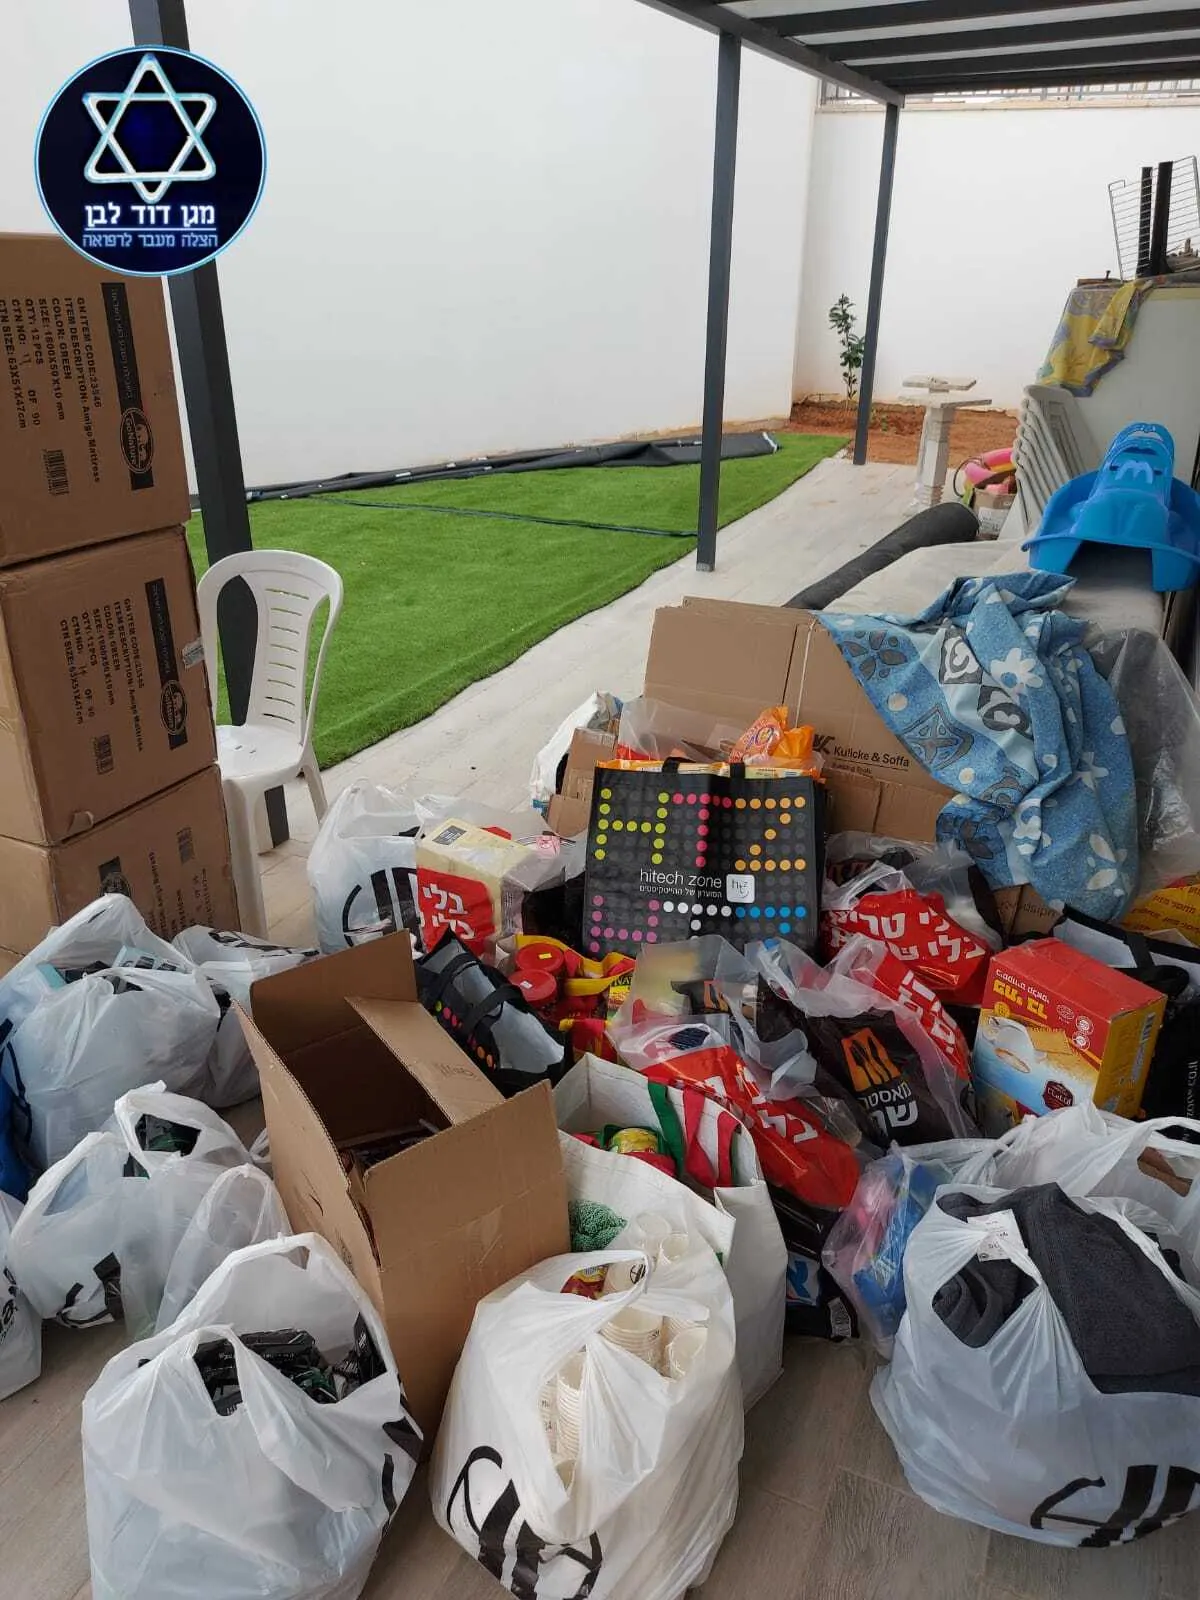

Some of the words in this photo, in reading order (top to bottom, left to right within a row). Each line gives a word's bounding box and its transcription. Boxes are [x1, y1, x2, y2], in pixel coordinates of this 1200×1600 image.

[39, 298, 51, 328] SIZE:
[80, 315, 92, 342] ITEM
[11, 298, 23, 324] CTN
[27, 389, 37, 405] OF
[59, 342, 72, 380] GREEN
[64, 297, 76, 324] ITEM
[87, 439, 102, 483] Mattress
[871, 752, 880, 762] &
[882, 753, 909, 767] Soffa
[640, 867, 684, 885] hitech
[688, 875, 722, 888] zone
[858, 1080, 912, 1109] מאסטר
